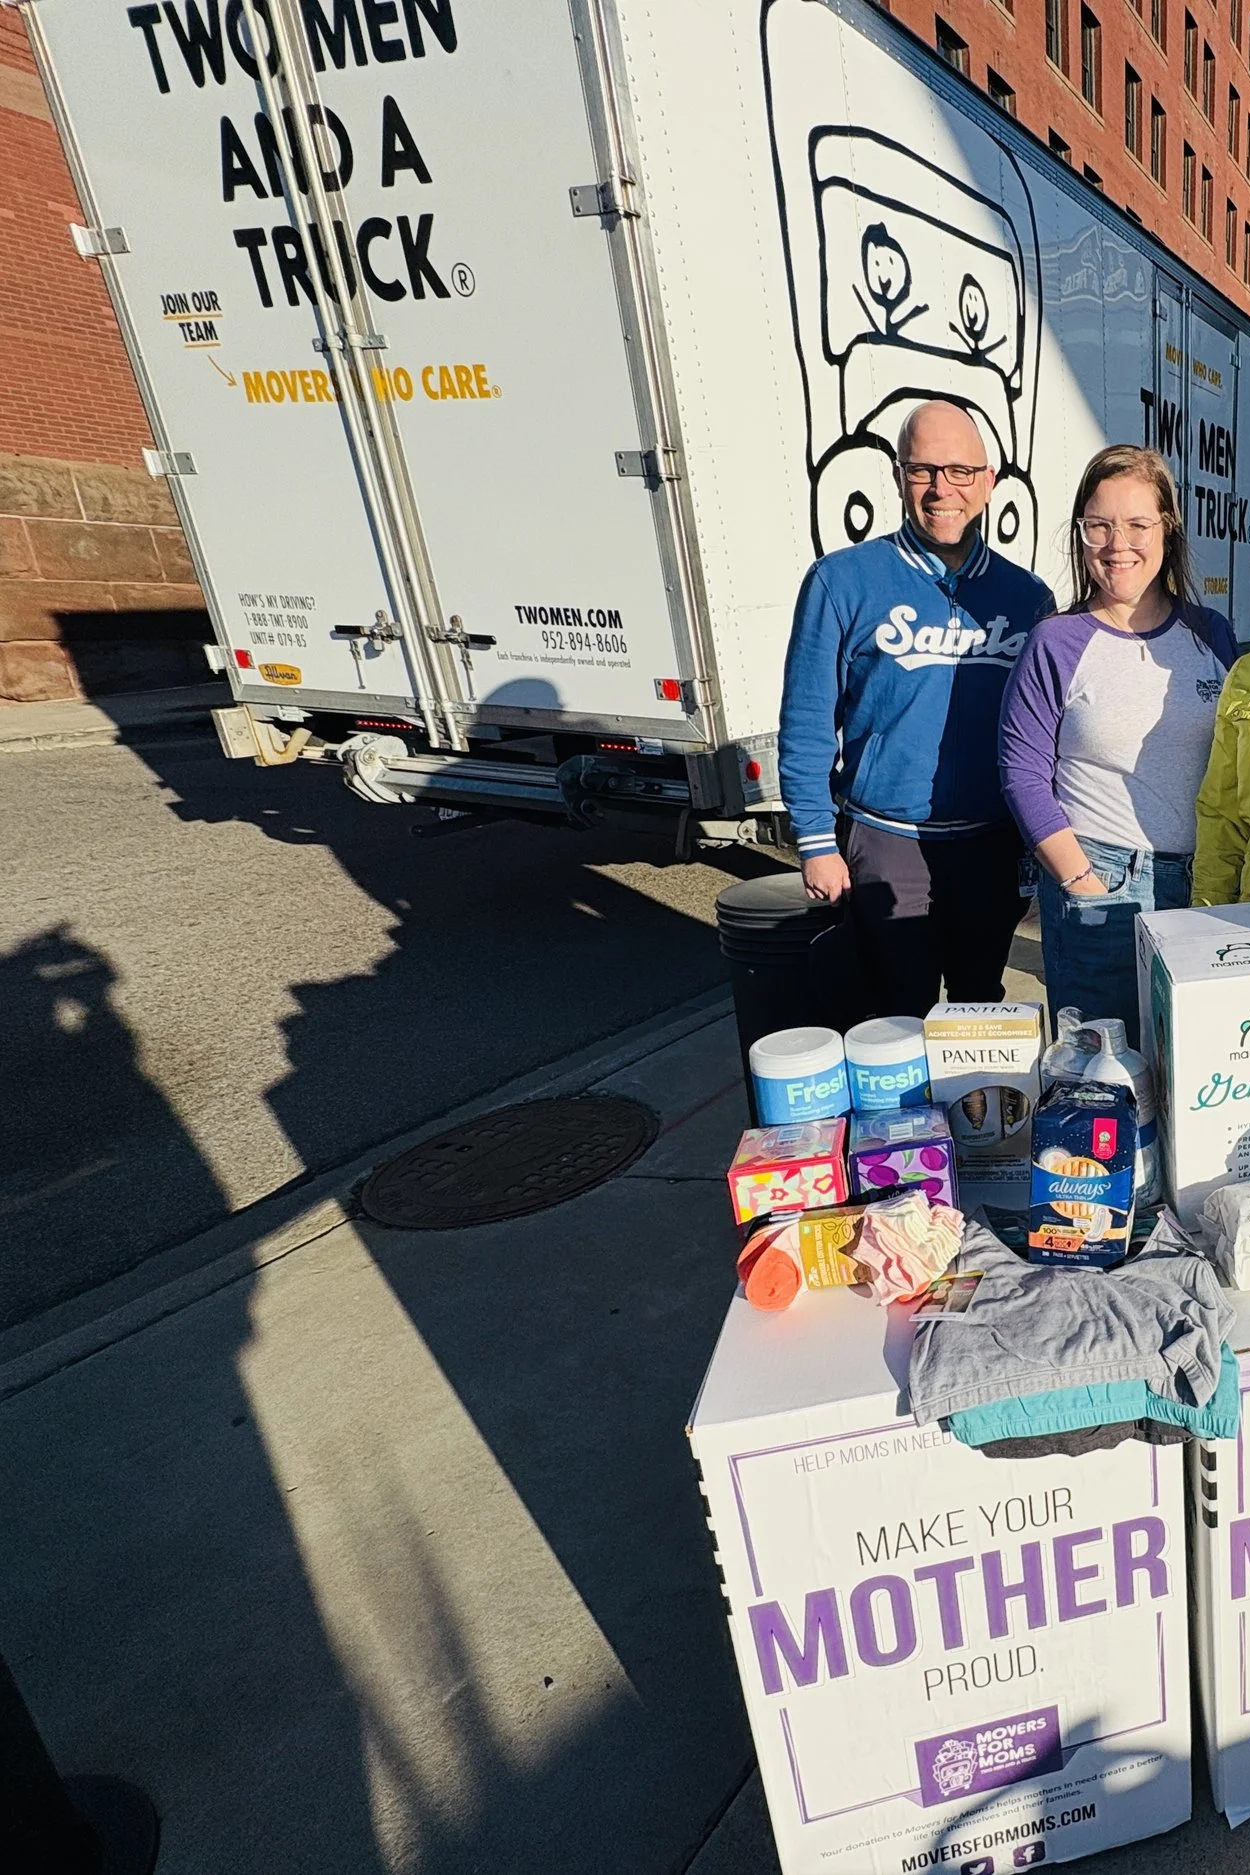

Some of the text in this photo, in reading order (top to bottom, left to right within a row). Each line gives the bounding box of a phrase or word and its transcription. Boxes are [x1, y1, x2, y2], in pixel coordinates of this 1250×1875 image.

[127, 0, 457, 94] TWO MEN
[221, 95, 433, 202] AND A
[160, 290, 222, 315] JOIN OUR
[178, 320, 219, 343] TEAM
[1140, 387, 1236, 480] TWO MEN
[238, 593, 316, 610] HOW'S MY DRIVING?
[244, 612, 308, 629] 1-888-TMT-8900
[514, 605, 623, 629] TWOMEN.COM
[278, 633, 307, 648] 079-85
[541, 630, 628, 653] 952-894-8606
[875, 604, 1028, 657] Saints
[510, 652, 533, 662] franchise
[540, 653, 576, 667] independently
[577, 656, 595, 667] owned
[596, 658, 606, 667] and
[607, 658, 632, 670] operated
[945, 1006, 1022, 1014] PANTENE
[942, 1048, 1021, 1064] PANTENE
[786, 1068, 848, 1105] Fresh
[856, 1065, 923, 1091] Fresh
[1238, 1164, 1249, 1172] UP
[1049, 1177, 1108, 1201] always
[1044, 1236, 1054, 1248] 4
[793, 1430, 952, 1474] HELP MOMS IN NEED
[856, 1486, 1074, 1567] MAKE YOUR
[747, 1516, 1171, 1696] MOTHER
[923, 1644, 1045, 1701] PROUD.
[975, 1717, 1047, 1745] MOVERS
[977, 1737, 1014, 1757] FOR
[978, 1743, 1036, 1769] MOMS
[820, 1848, 843, 1860] Your
[845, 1834, 891, 1852] donation
[892, 1830, 903, 1840] to
[905, 1819, 941, 1835] Movers
[943, 1814, 958, 1825] for
[996, 1795, 1022, 1810] helps
[1023, 1785, 1062, 1801] mothers
[1064, 1781, 1073, 1791] in
[1075, 1774, 1098, 1787] need
[1099, 1767, 1127, 1780] create
[1136, 1754, 1164, 1768] better
[913, 1790, 1085, 1842] life for themselves and their families.
[901, 1803, 1097, 1873] MOVERSFORMOMS.COM
